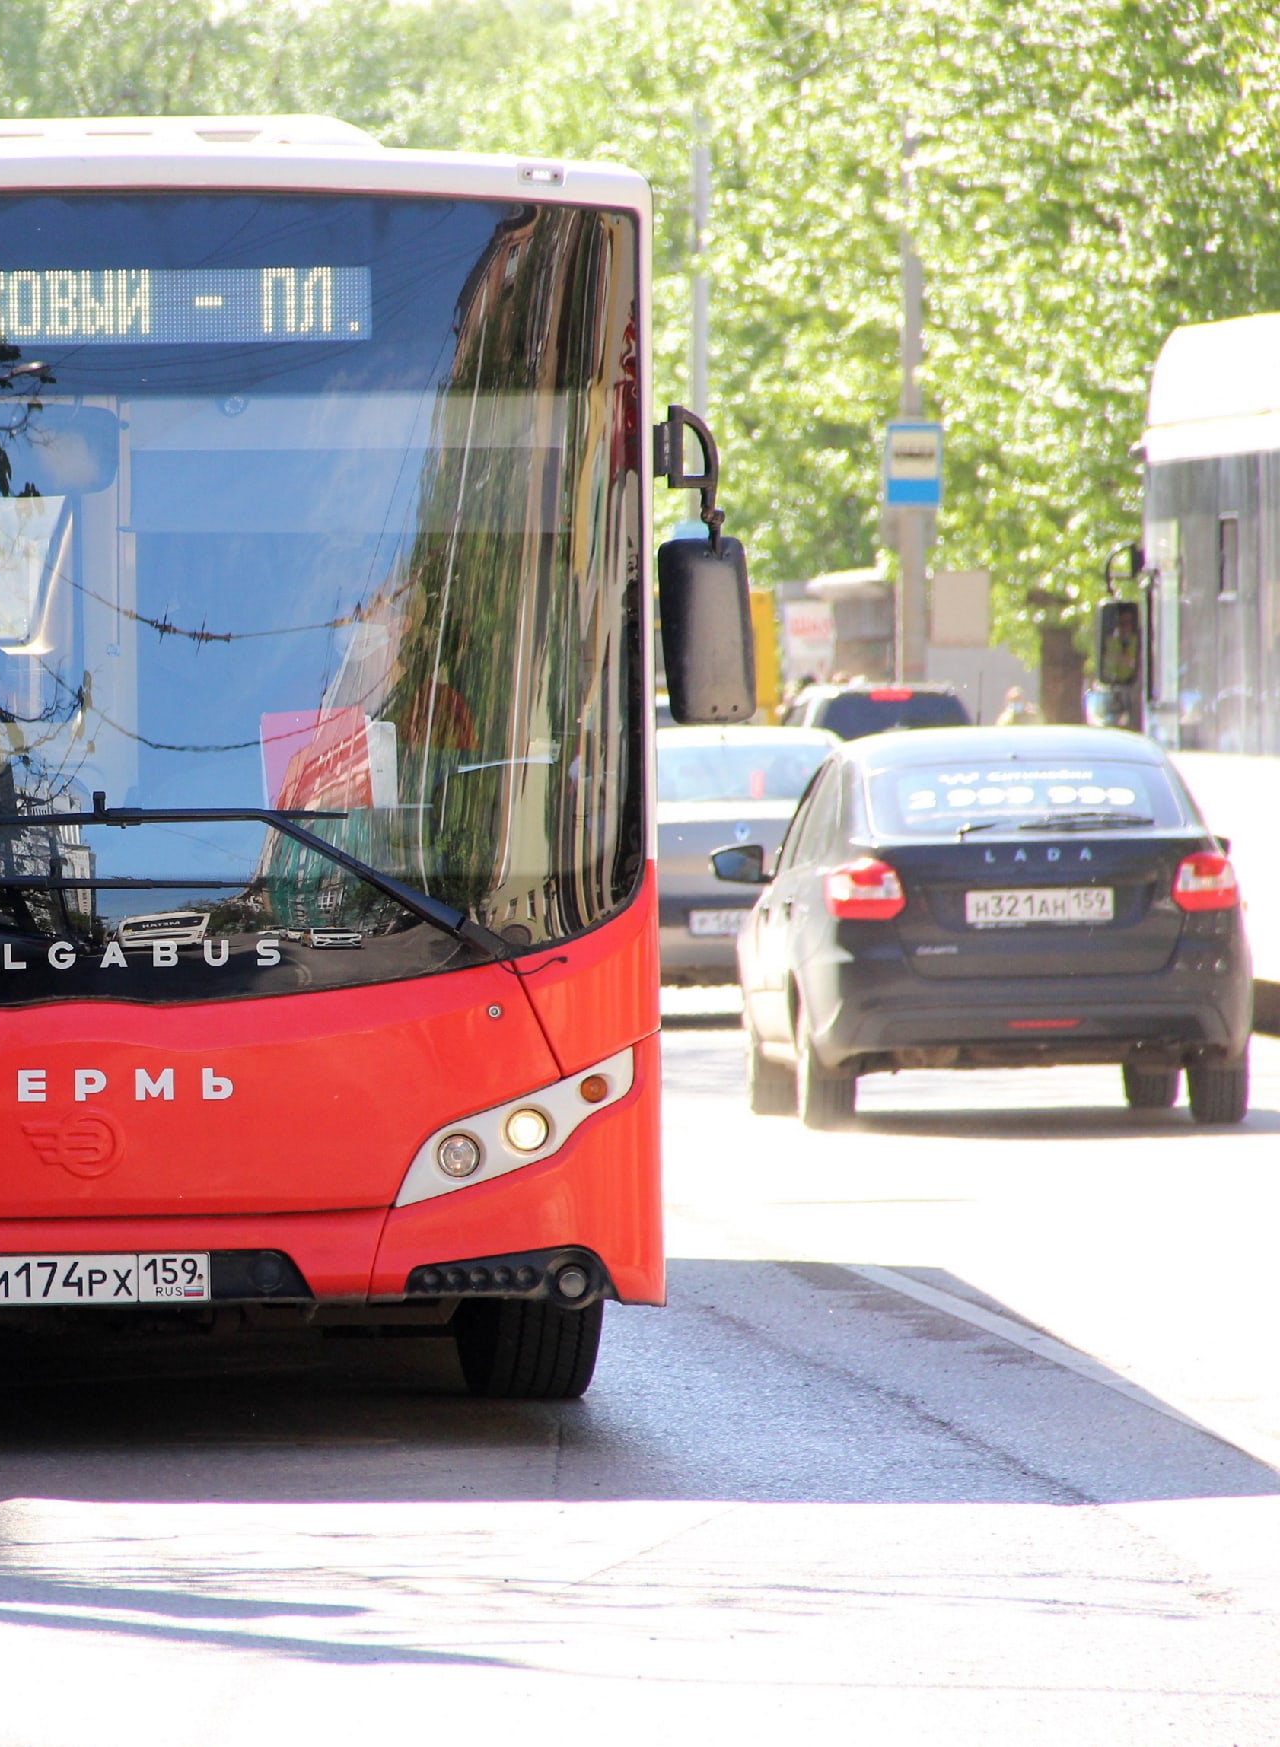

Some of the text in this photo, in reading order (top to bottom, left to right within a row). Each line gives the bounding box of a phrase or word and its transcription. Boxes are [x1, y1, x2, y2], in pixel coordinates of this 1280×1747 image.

[263, 267, 359, 332] ПЛ.
[984, 848, 1092, 863] LADA
[144, 1258, 198, 1285] 159
[155, 1286, 183, 1297] RUS
